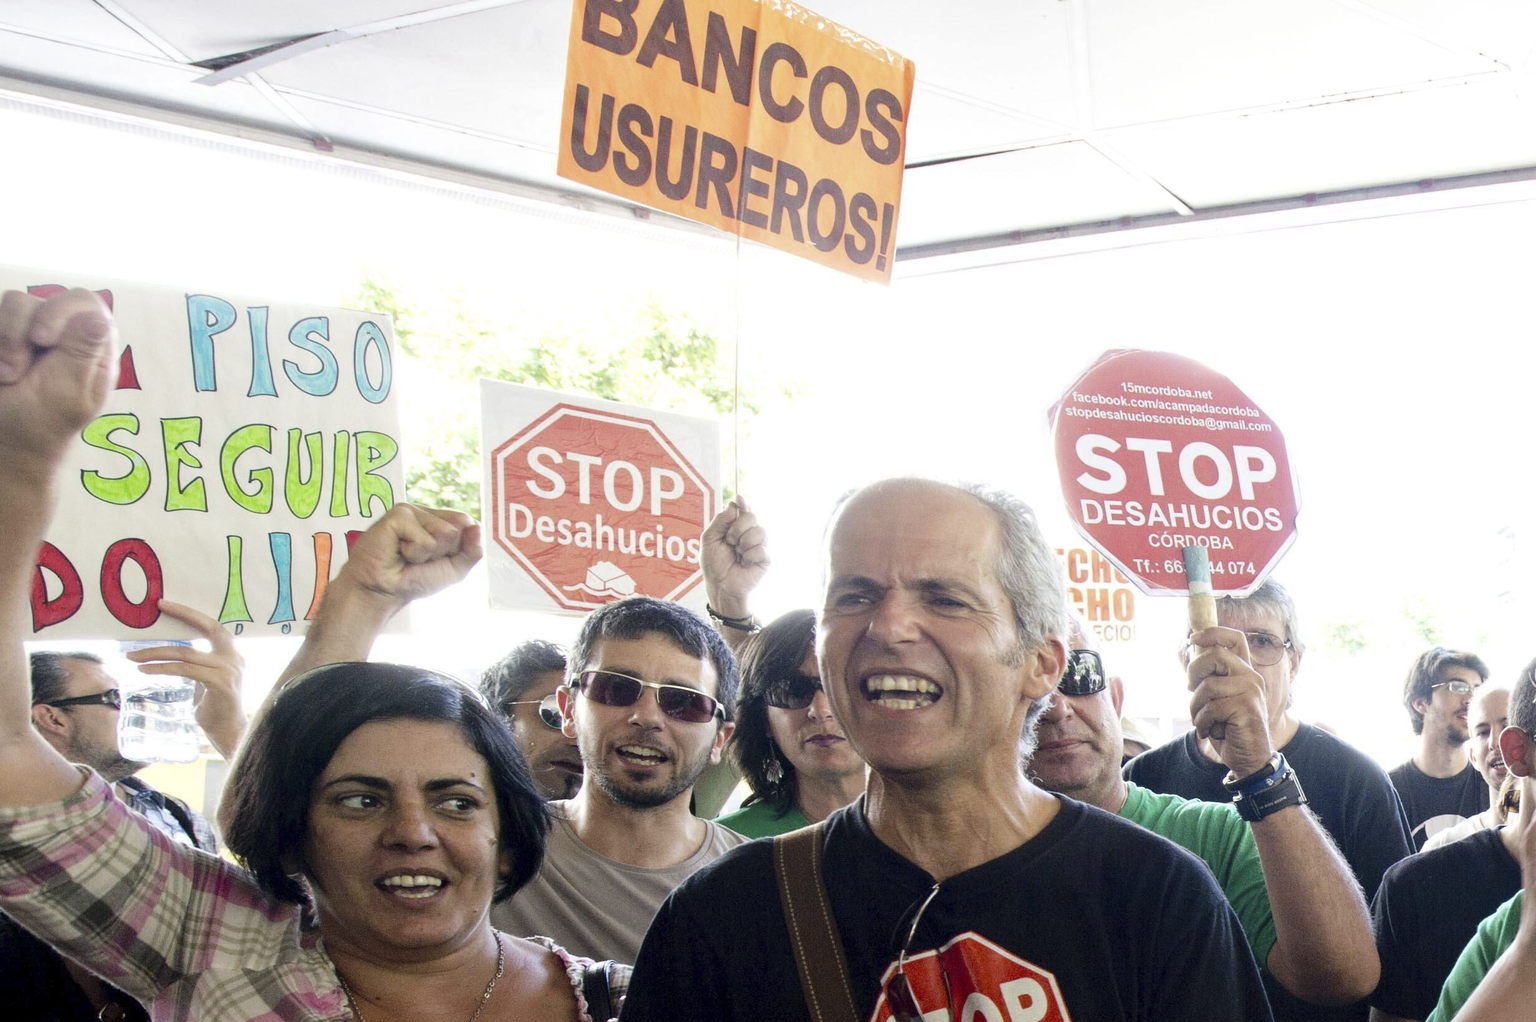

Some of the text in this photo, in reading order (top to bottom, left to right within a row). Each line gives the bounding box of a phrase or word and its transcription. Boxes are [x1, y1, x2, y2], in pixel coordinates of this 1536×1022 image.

[582, 0, 903, 165] BANCOS
[570, 84, 894, 272] USUREROS!
[185, 293, 393, 404] PISO
[1065, 406, 1272, 433] stopdesahucioscordoba@gmail.com
[1072, 391, 1261, 418] facebook.com/acampadacordoba
[1121, 382, 1213, 400] 15mcordoba.net
[81, 413, 399, 519] SEGUIR
[525, 446, 685, 516] STOP
[1075, 434, 1277, 500] STOP
[509, 503, 700, 565] Desahucios
[1080, 499, 1283, 531] DESAHUCIOS
[1148, 532, 1234, 549] CÓRDOBA
[1228, 561, 1256, 575] 074
